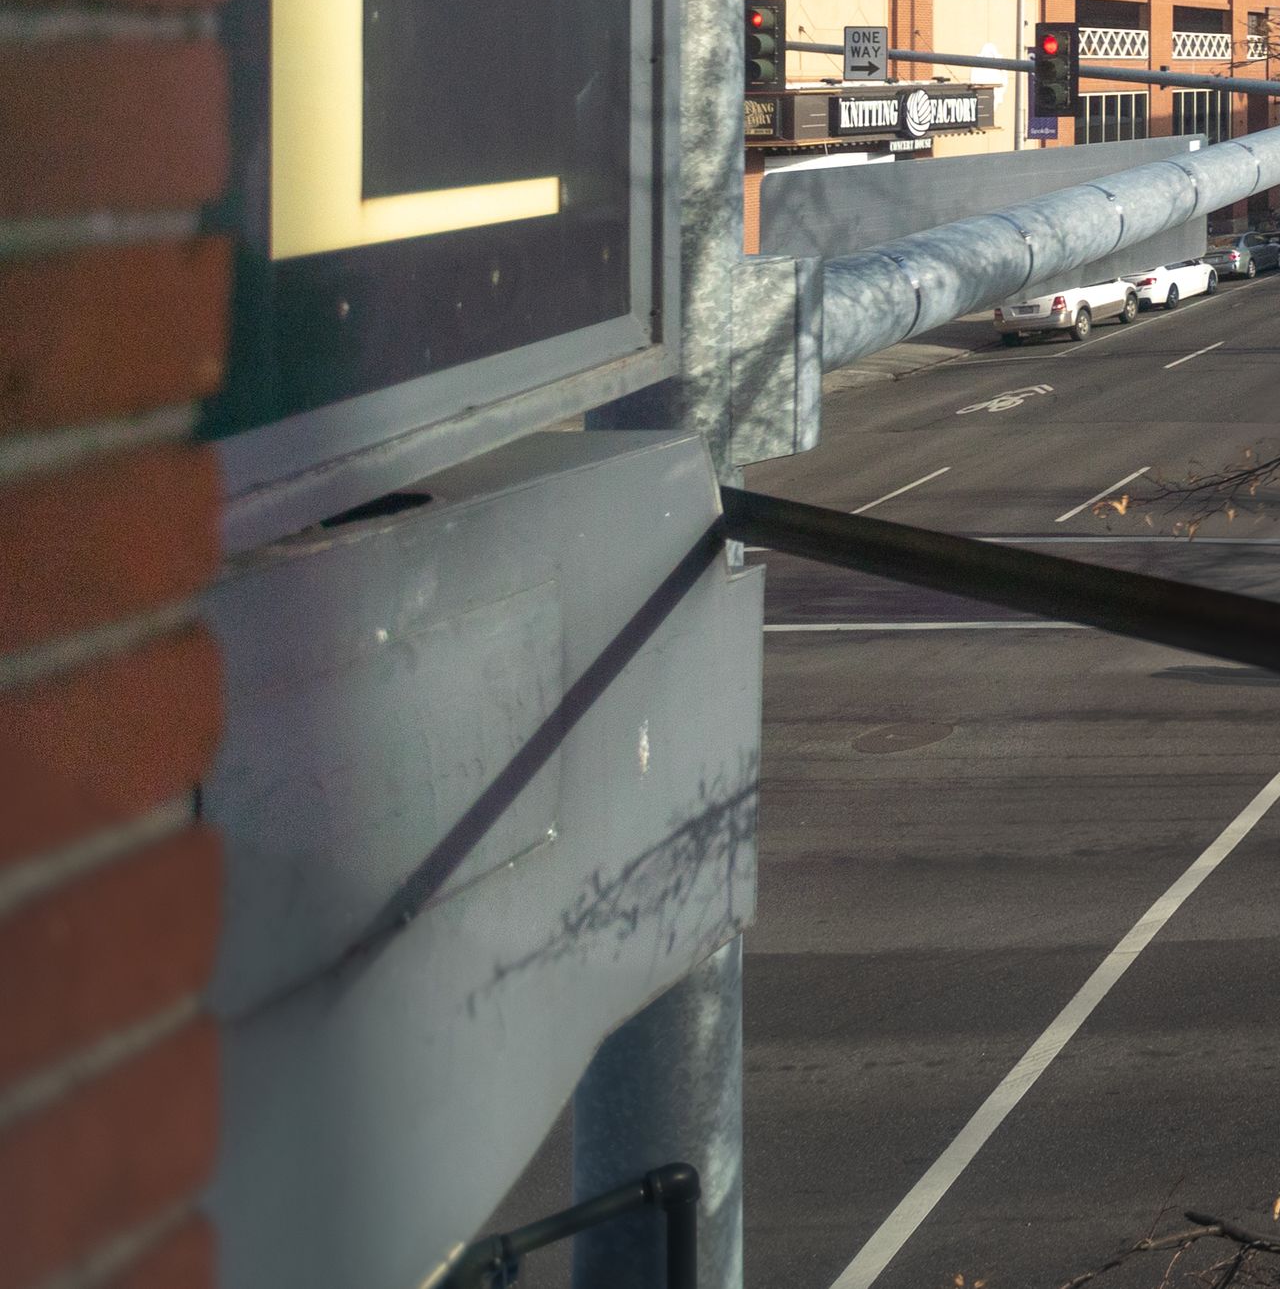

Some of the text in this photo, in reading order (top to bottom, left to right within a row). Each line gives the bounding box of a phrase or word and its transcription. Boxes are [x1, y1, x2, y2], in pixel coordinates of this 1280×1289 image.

[852, 31, 880, 44] ONE
[851, 46, 881, 58] WAY
[839, 98, 977, 128] KNITTING FACTORY
[889, 138, 932, 152] CONCERT HOUSE
